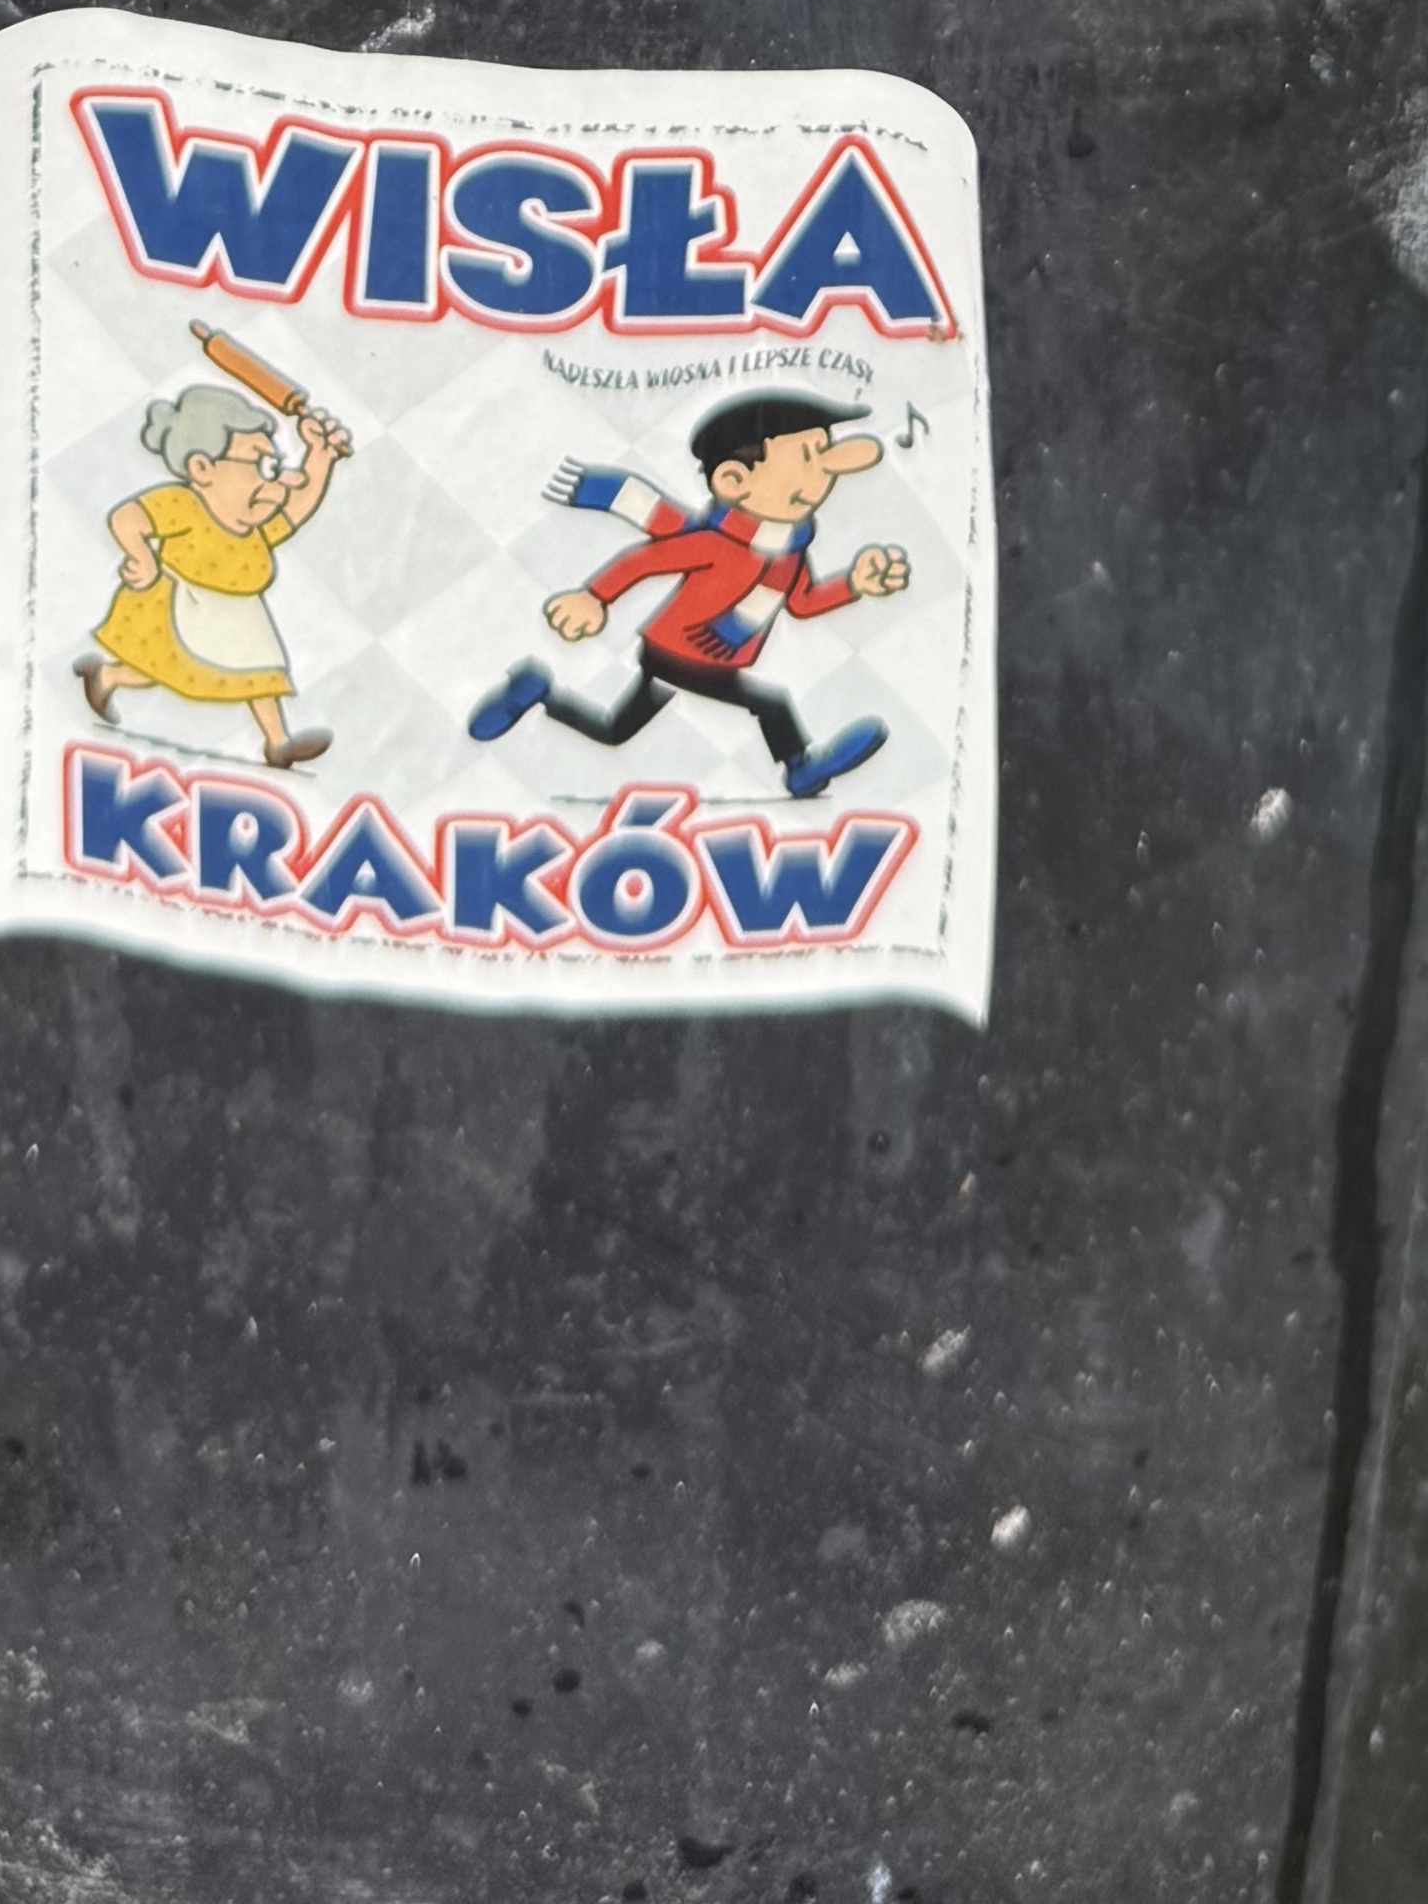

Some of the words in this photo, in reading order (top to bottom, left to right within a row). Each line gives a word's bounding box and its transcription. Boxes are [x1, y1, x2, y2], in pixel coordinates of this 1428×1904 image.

[72, 88, 955, 337] WISŁA
[646, 358, 722, 389] WIOSNA
[741, 346, 812, 373] LEPSZE
[818, 347, 874, 384] CZASY
[64, 743, 919, 952] KRAKÓW
